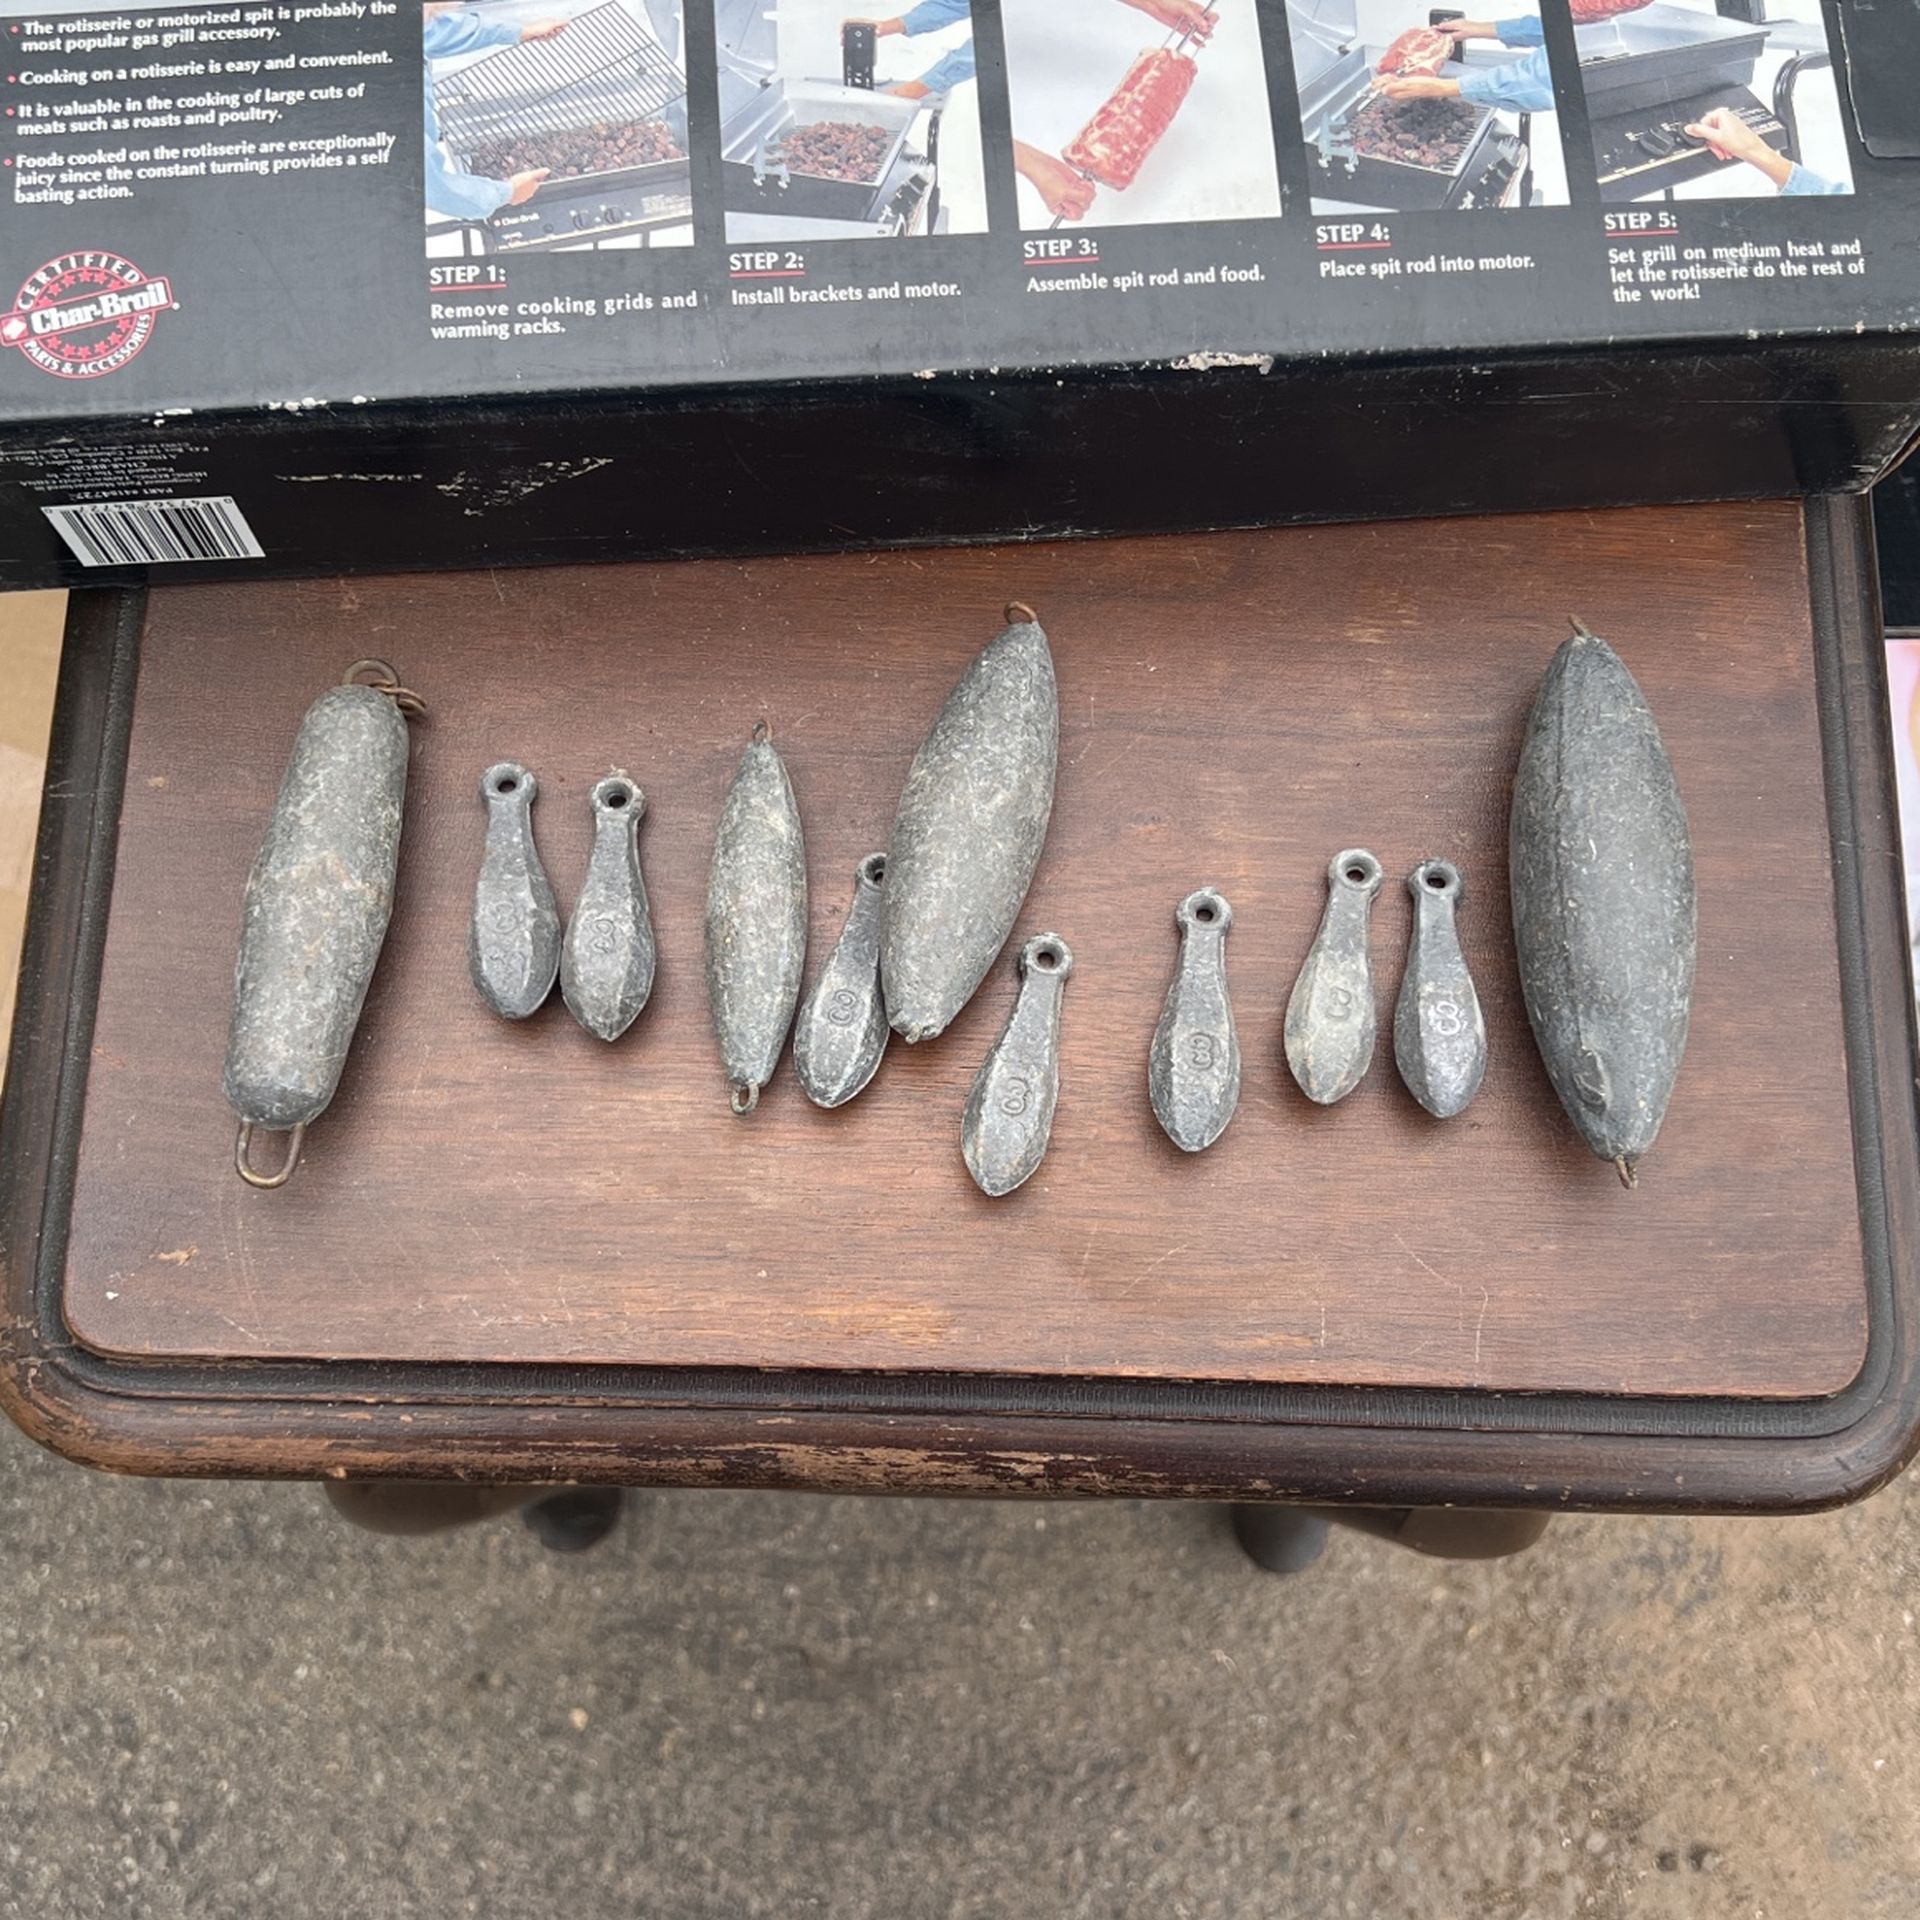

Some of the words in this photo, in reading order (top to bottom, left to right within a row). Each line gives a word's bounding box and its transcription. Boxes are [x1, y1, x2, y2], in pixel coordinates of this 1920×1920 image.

[24, 21, 53, 36] The
[58, 18, 131, 33] rotisserie
[136, 17, 154, 29] or
[158, 10, 240, 28] motorized
[245, 8, 274, 25] spit
[278, 7, 290, 20] is
[295, 3, 366, 20] probably
[371, 1, 397, 15] the
[22, 38, 62, 53] most
[66, 34, 129, 53] popular
[132, 33, 159, 48] gas
[163, 27, 195, 47] grill
[198, 26, 281, 43] accessory.
[20, 69, 88, 86] Cooking
[91, 69, 113, 81] on
[117, 68, 127, 80] a
[131, 61, 205, 78] rotisserie
[209, 60, 222, 74] is
[225, 60, 261, 75] easy
[265, 54, 295, 70] and
[299, 50, 393, 68] convenient.
[19, 104, 32, 118] It
[36, 103, 50, 117] is
[53, 99, 122, 116] valuable
[126, 97, 142, 112] in
[146, 95, 172, 110] the
[177, 91, 240, 109] cooking
[244, 88, 262, 103] of
[265, 86, 305, 103] large
[309, 86, 343, 99] cuts
[347, 83, 365, 97] of
[17, 121, 66, 135] meats
[70, 116, 108, 132] such
[111, 116, 130, 130] as
[133, 113, 181, 128] roasts
[184, 109, 215, 126] and
[219, 108, 283, 126] poultry.
[16, 153, 65, 169] Foods
[68, 148, 126, 165] cooked
[129, 149, 151, 161] on
[154, 144, 179, 160] the
[182, 141, 256, 158] rotisserie
[259, 141, 285, 153] are
[288, 132, 396, 152] exceptionally
[15, 170, 55, 187] juicy
[59, 168, 102, 183] since
[106, 166, 133, 181] the
[137, 163, 207, 179] constant
[210, 158, 270, 176] turning
[273, 154, 343, 174] provides
[346, 153, 357, 165] a
[361, 149, 390, 164] self
[15, 188, 74, 205] basting
[77, 186, 134, 200] action.
[1316, 225, 1364, 243] STEP
[1370, 224, 1390, 241] 4:
[1604, 213, 1652, 230] STEP
[1659, 212, 1677, 228] 5:
[729, 252, 779, 271] STEP
[784, 251, 804, 269] 2:
[1024, 239, 1072, 258] STEP
[1079, 238, 1098, 255] 3:
[1608, 248, 1636, 264] Set
[1642, 245, 1676, 267] grill
[1683, 247, 1706, 261] on
[1712, 241, 1781, 260] medium
[1787, 240, 1825, 257] heat
[1831, 238, 1861, 255] and
[429, 266, 481, 285] STEP
[487, 265, 506, 282] 1:
[1026, 273, 1108, 292] Assemble
[1113, 271, 1144, 292] spit
[1149, 268, 1179, 286] rod
[1184, 266, 1215, 284] and
[1220, 264, 1265, 283] food.
[1319, 260, 1366, 278] Place
[1370, 258, 1401, 280] spit
[1406, 256, 1436, 274] rod
[1440, 255, 1475, 272] into
[1479, 254, 1535, 271] motor.
[1610, 267, 1634, 283] let
[1638, 265, 1667, 282] the
[1671, 262, 1748, 280] rotisserie
[1753, 260, 1775, 278] do
[1780, 259, 1807, 277] the
[1812, 261, 1843, 275] rest
[1847, 258, 1866, 274] of
[18, 254, 140, 310] CERTIFIED
[731, 287, 784, 305] Install
[789, 284, 863, 303] brackets
[867, 282, 900, 299] and
[905, 282, 961, 299] motor.
[1612, 285, 1641, 303] the
[1649, 283, 1701, 301] work!
[31, 281, 169, 335] Char-Broil
[431, 303, 509, 320] Remove
[517, 297, 597, 316] cooking
[604, 293, 654, 315] grids
[661, 291, 698, 308] and
[430, 320, 510, 339] warming
[514, 318, 566, 335] racks.
[24, 341, 59, 371] PARTS
[61, 363, 74, 374] &
[79, 313, 151, 375] ACCESSORIES
